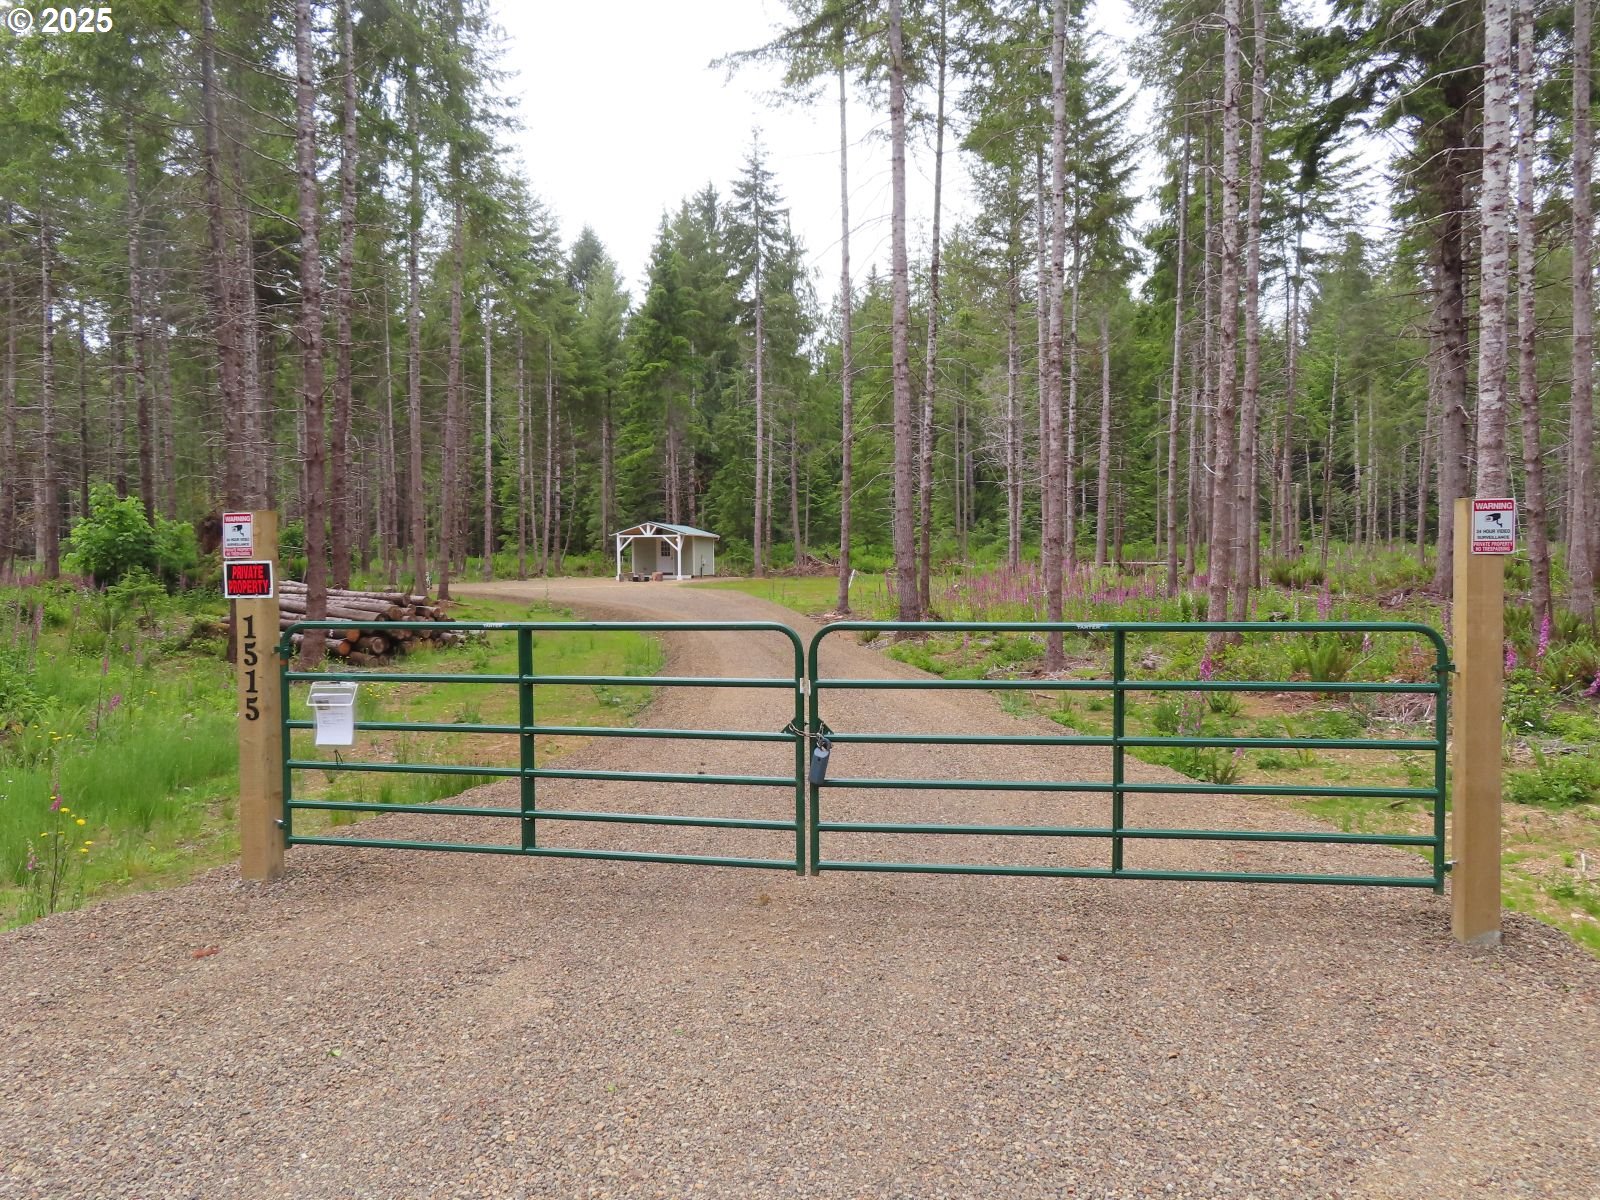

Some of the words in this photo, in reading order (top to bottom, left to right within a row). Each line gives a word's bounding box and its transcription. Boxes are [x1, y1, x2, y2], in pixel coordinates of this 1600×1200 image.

[1475, 502, 1513, 510] WARNING
[232, 565, 264, 579] PRIVATE
[228, 579, 269, 594] PROPERTY
[243, 614, 260, 721] 1515
